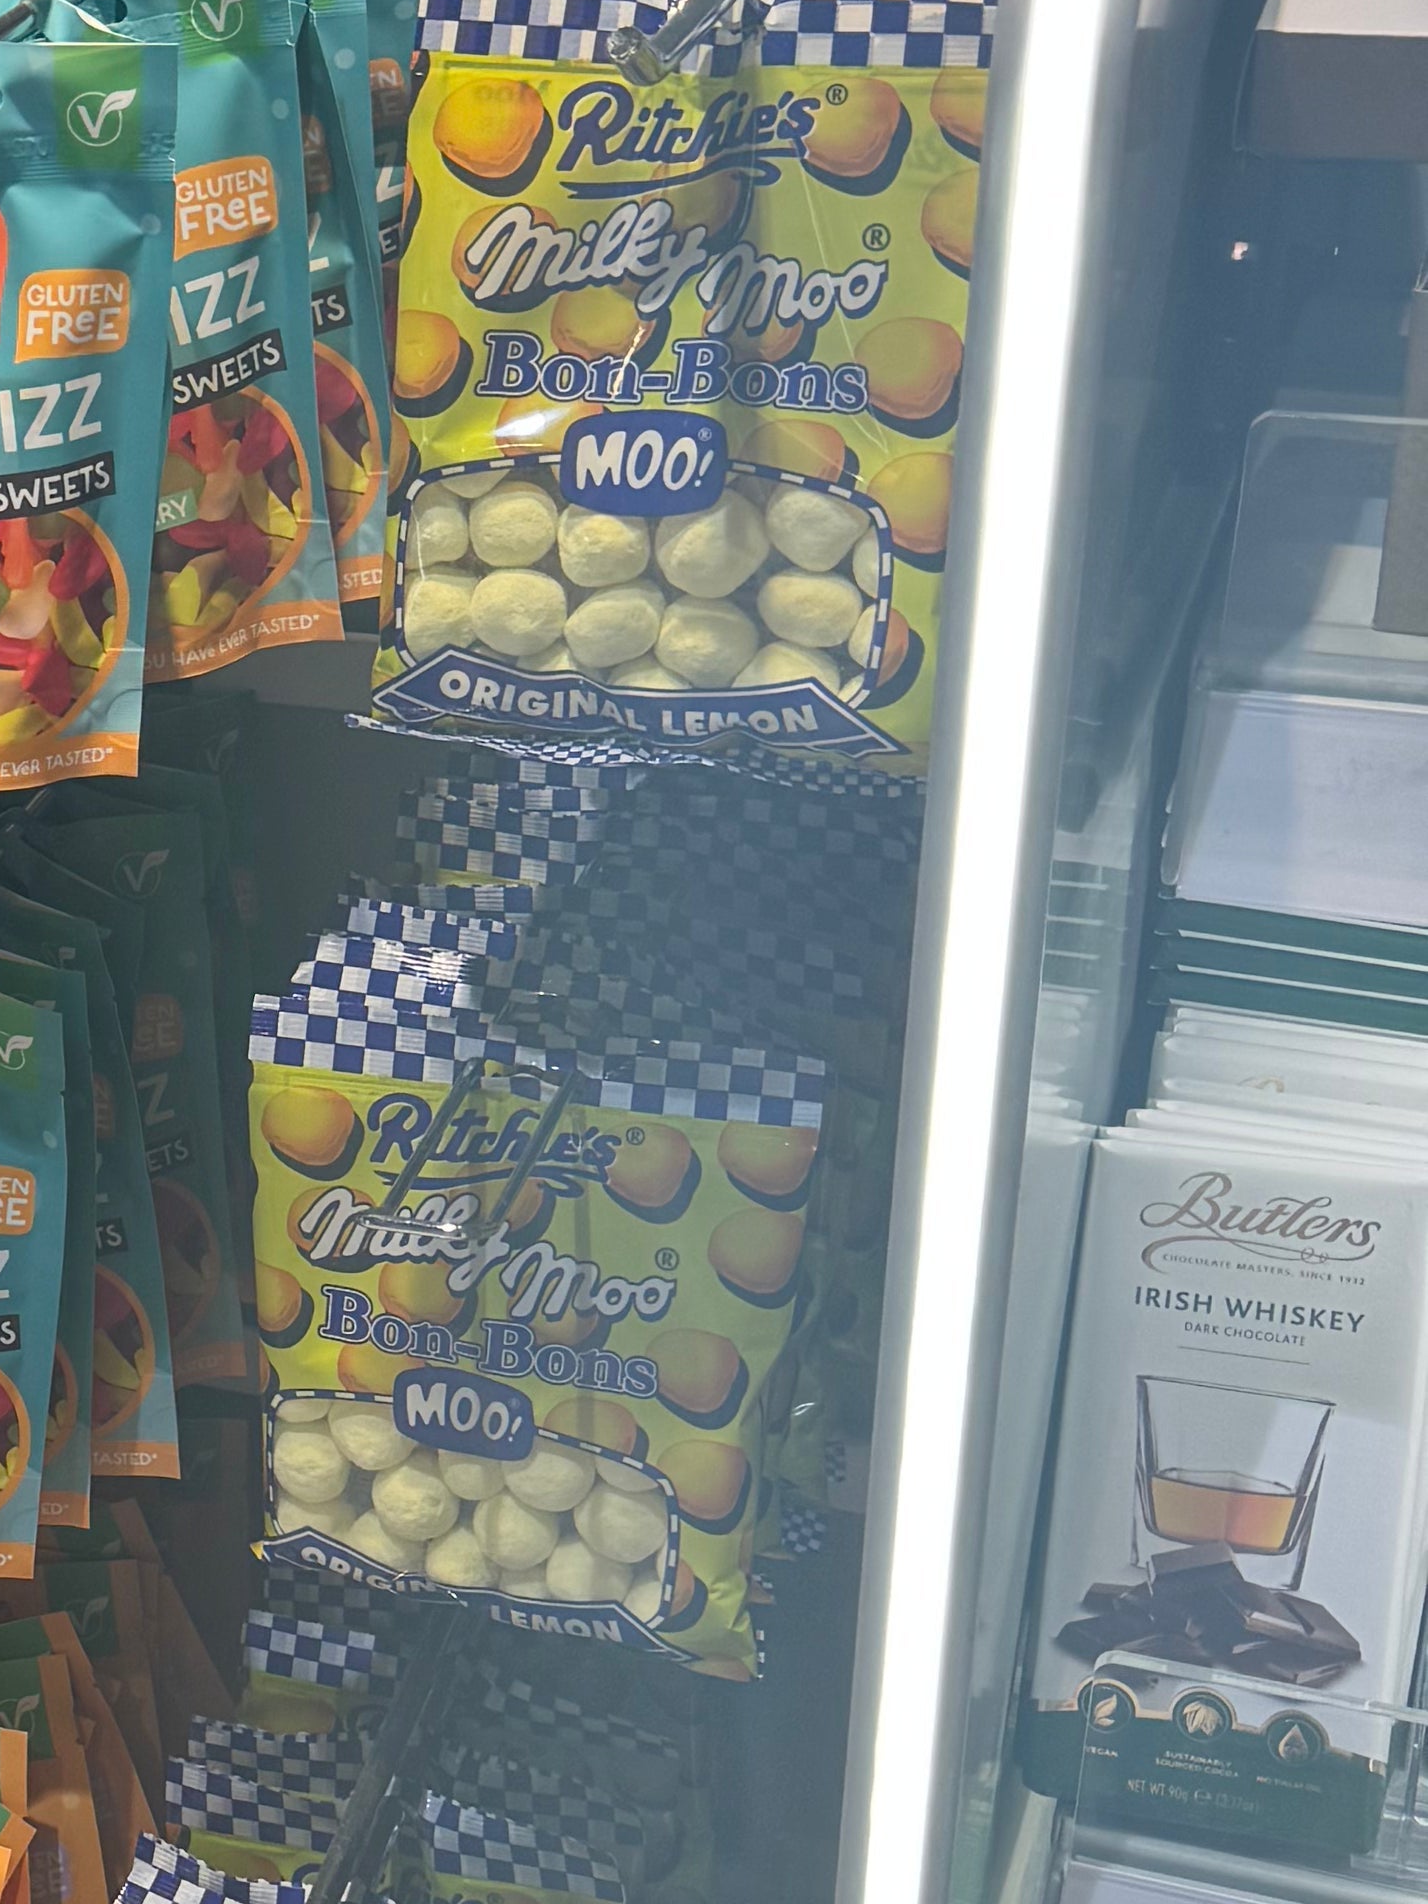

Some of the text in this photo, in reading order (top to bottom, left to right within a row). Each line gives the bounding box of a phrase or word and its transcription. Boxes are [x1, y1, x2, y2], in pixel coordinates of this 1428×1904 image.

[557, 84, 819, 173] Ritchie's
[26, 282, 124, 310] GLUTEN
[467, 200, 888, 336] Milky Moo
[476, 332, 869, 412] Bon-Bons
[575, 429, 711, 491] MOO!
[438, 670, 817, 738] ORIGINAL LEMON
[1140, 1171, 1381, 1246] Butlers
[1135, 1286, 1365, 1333] IRISH WHISKEY
[1184, 1321, 1306, 1346] DARK CHOCOLATE
